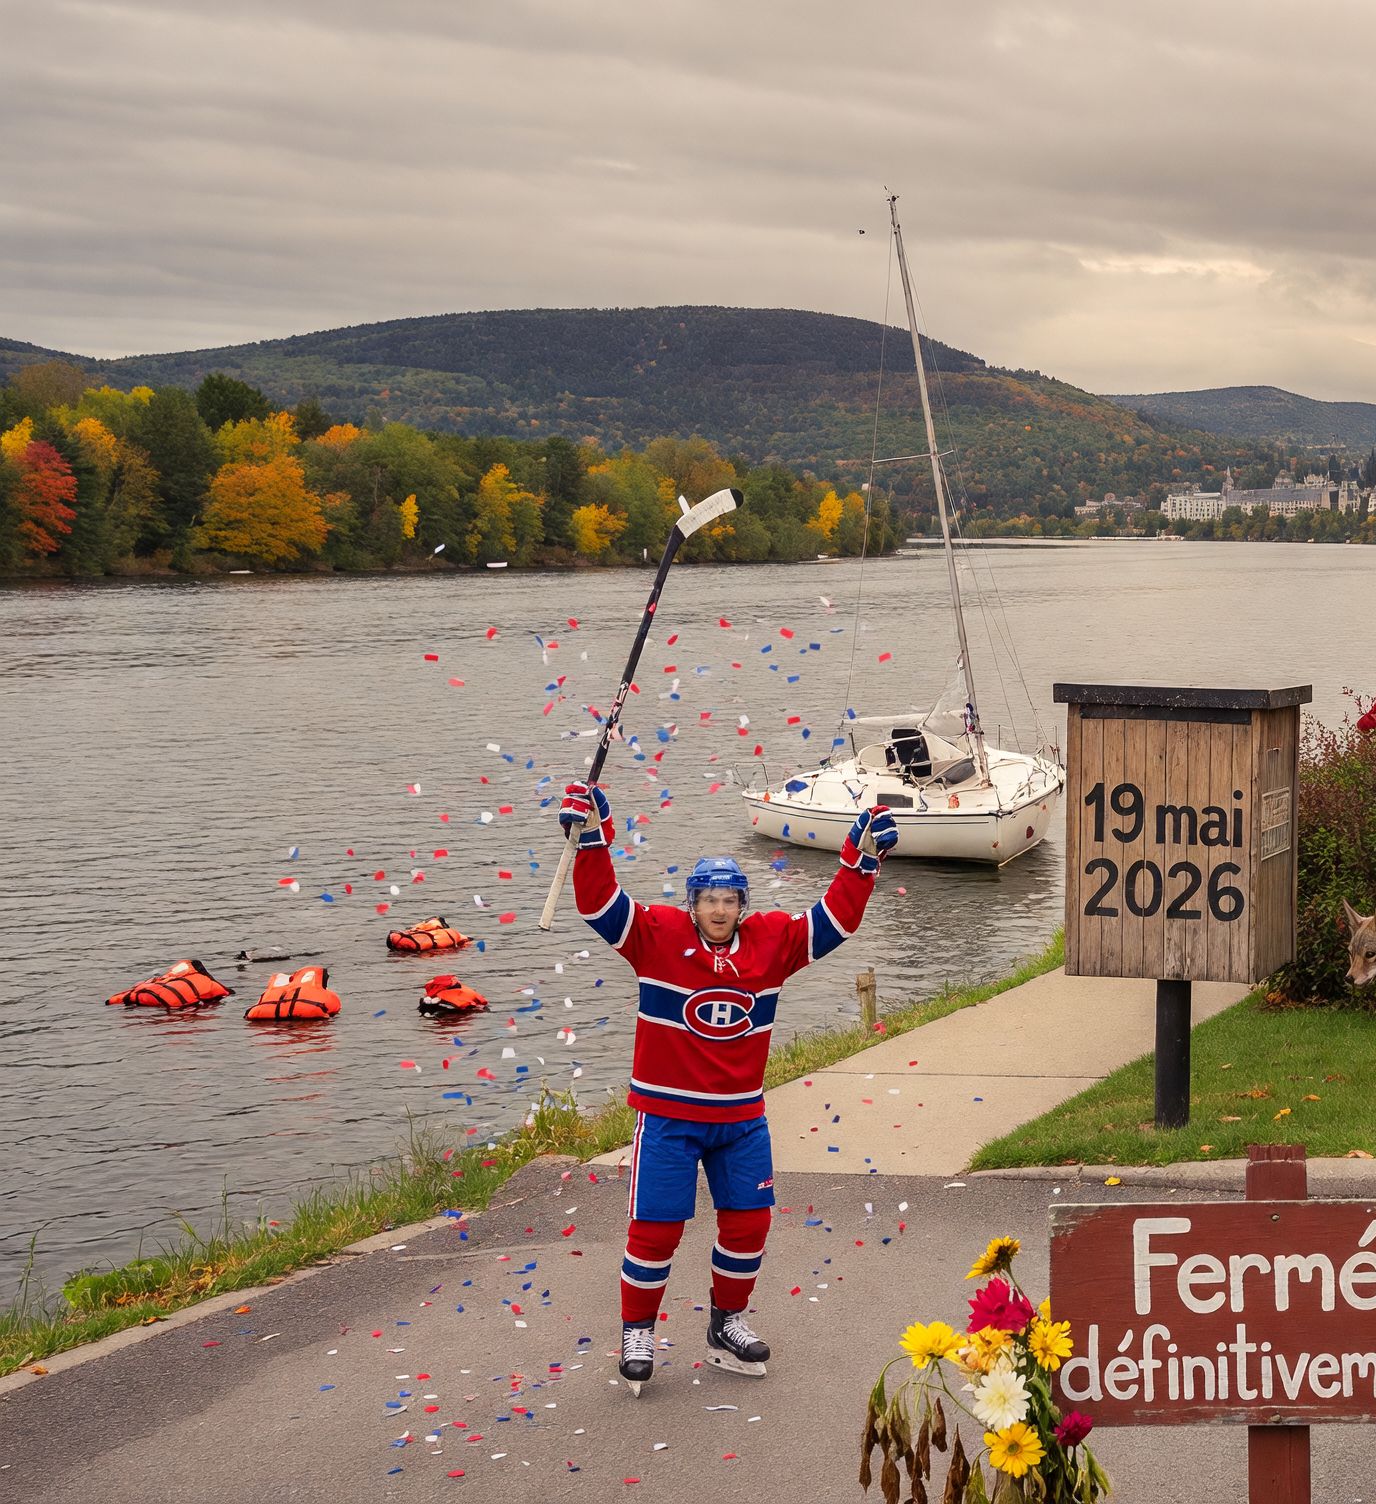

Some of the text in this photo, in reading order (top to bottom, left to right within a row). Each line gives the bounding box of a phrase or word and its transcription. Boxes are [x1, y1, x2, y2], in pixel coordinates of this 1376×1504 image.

[1084, 782, 1244, 848] 19 mai
[1083, 857, 1245, 922] 2026
